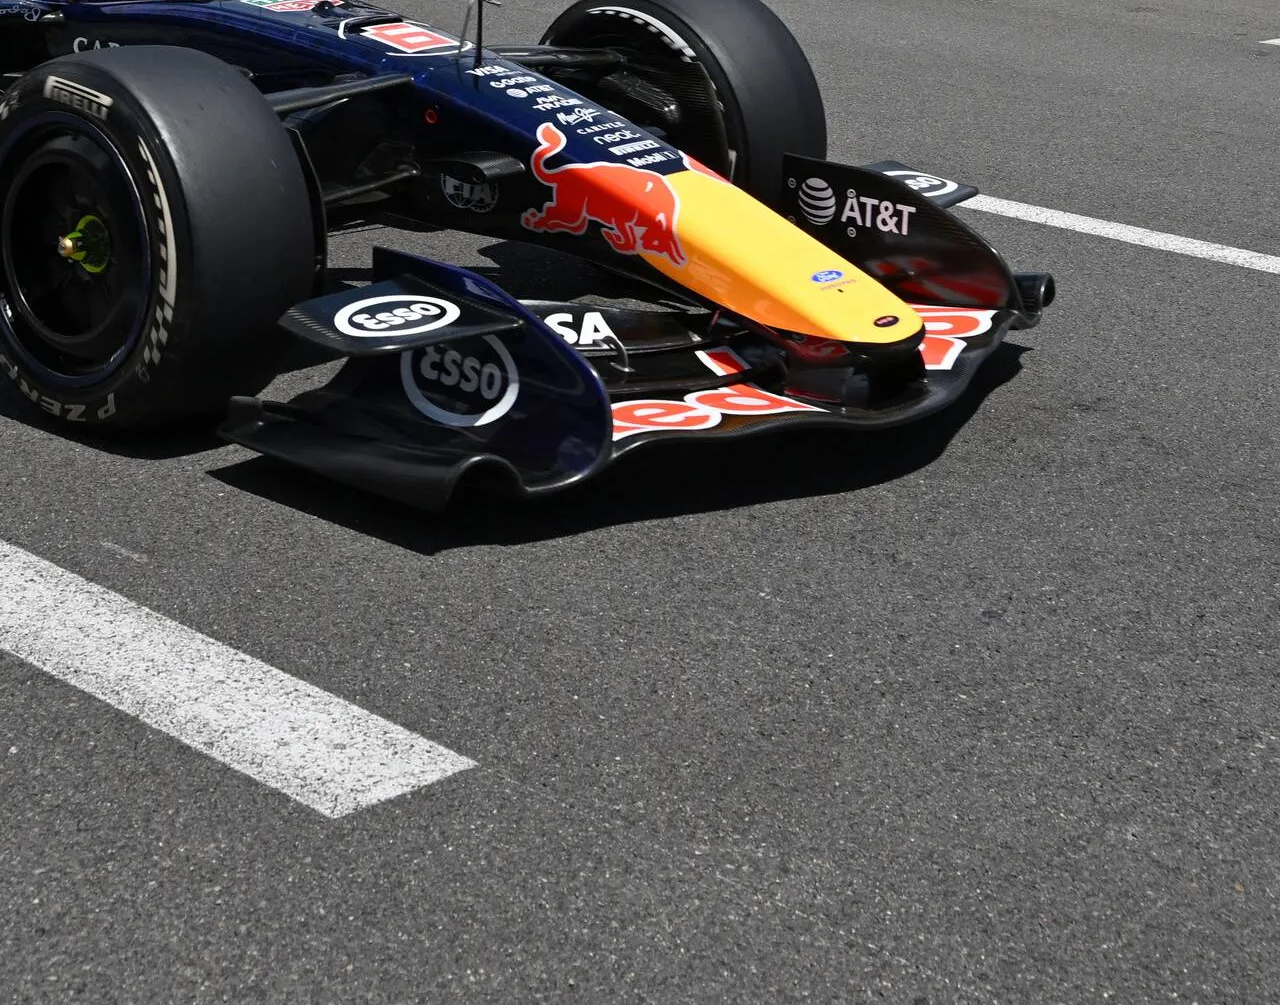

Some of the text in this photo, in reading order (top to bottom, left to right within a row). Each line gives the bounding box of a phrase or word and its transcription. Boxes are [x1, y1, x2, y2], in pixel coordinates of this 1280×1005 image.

[43, 74, 114, 121] PIRELLI
[576, 121, 626, 135] CARLYLE
[442, 175, 493, 204] FIA
[840, 196, 917, 236] AT&T
[543, 311, 621, 346] SA
[97, 393, 117, 420] P
[611, 346, 832, 442] ed
